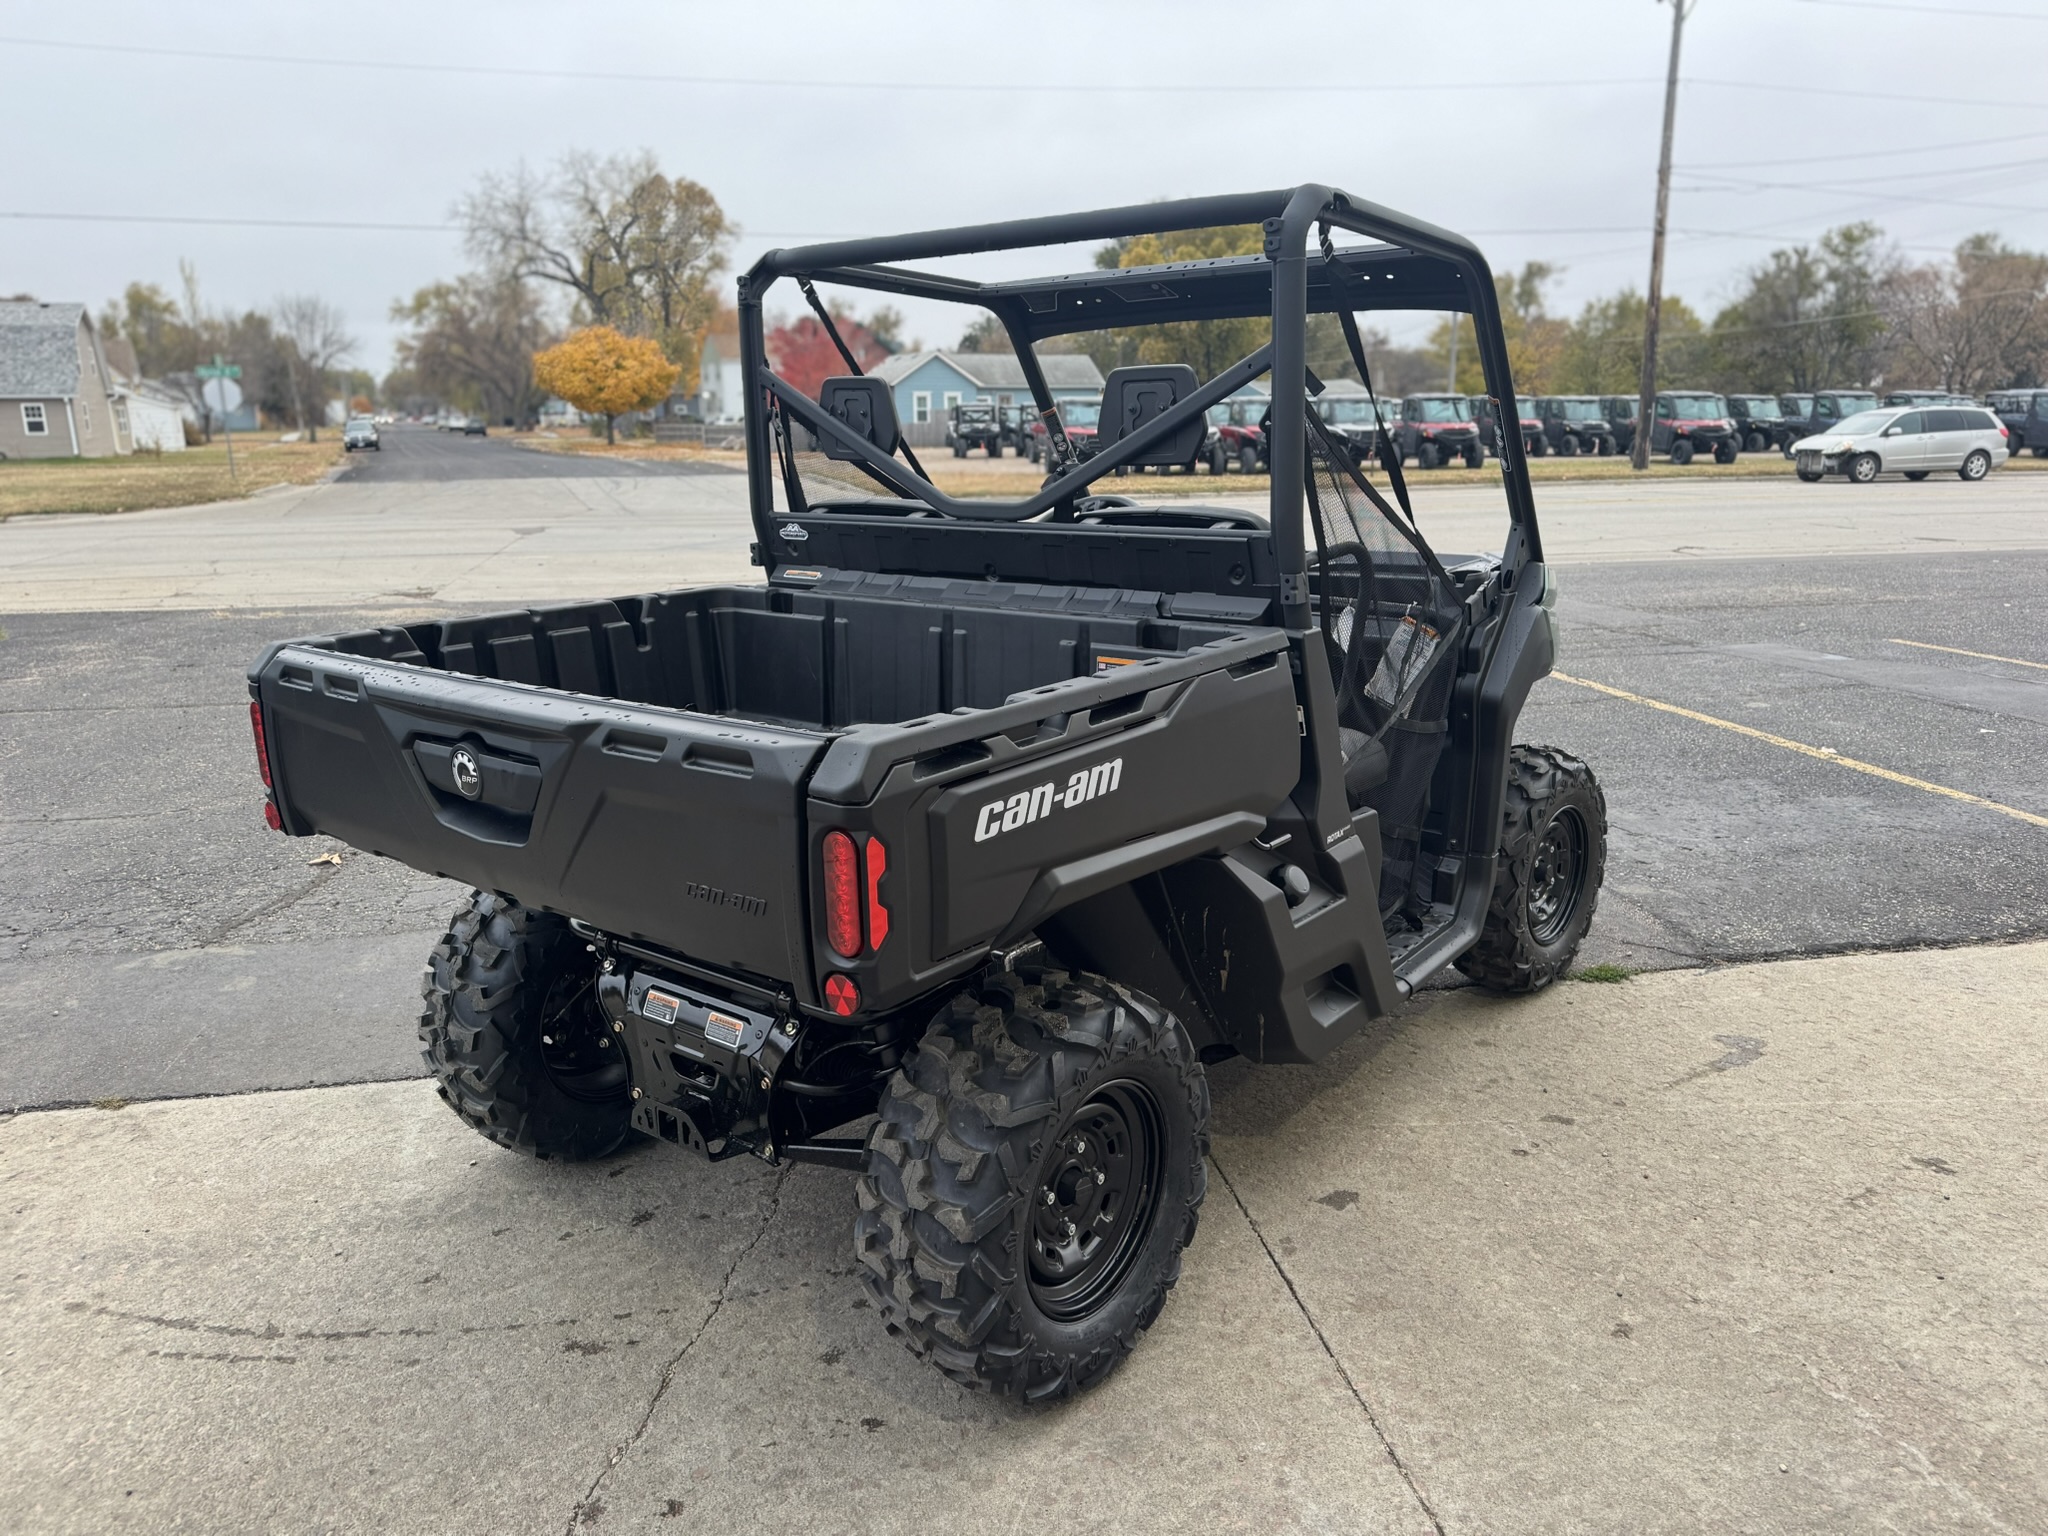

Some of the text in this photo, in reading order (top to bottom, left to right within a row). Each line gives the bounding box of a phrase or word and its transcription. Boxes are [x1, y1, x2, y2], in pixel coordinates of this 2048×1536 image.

[461, 774, 478, 784] BRP
[975, 757, 1123, 843] can-am
[1327, 825, 1350, 845] ROTAX
[686, 881, 767, 917] can-am
